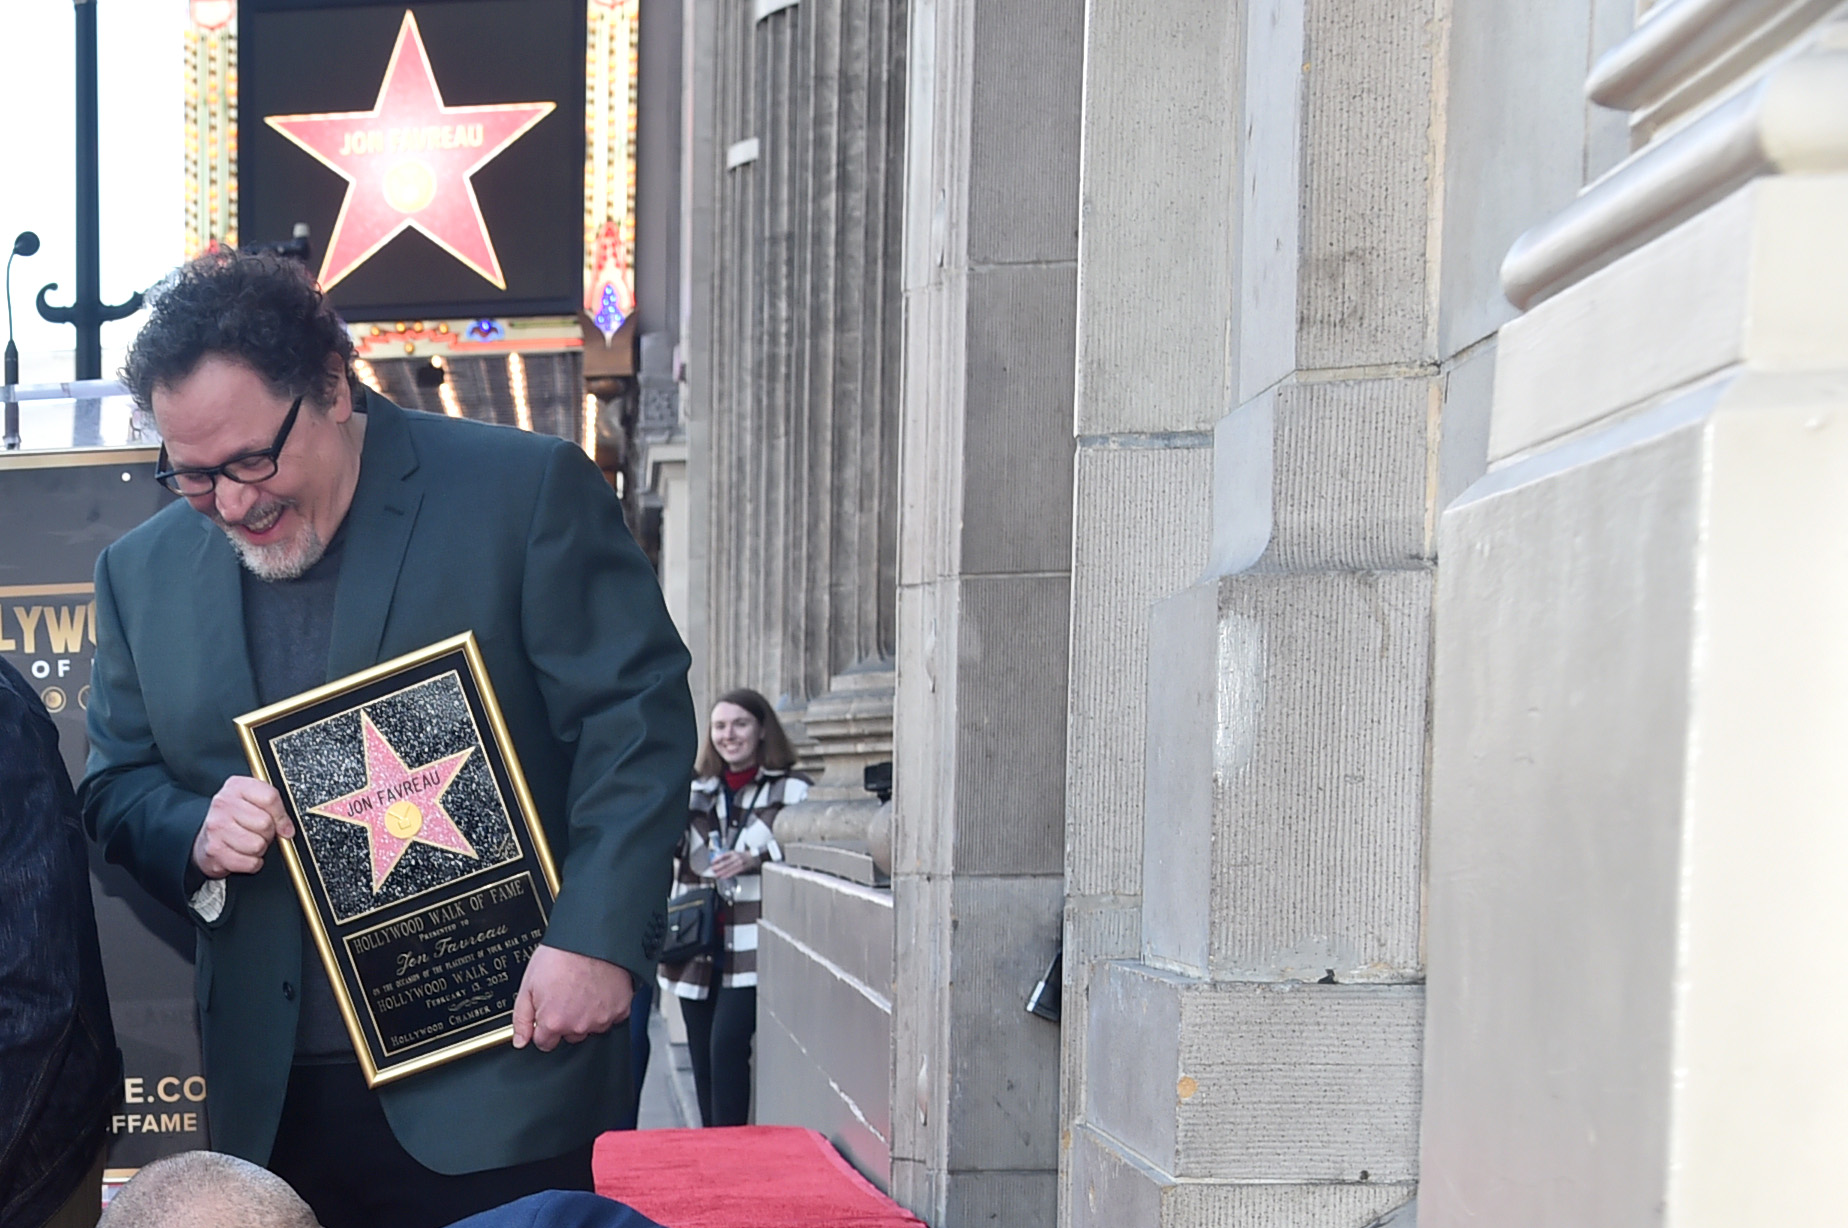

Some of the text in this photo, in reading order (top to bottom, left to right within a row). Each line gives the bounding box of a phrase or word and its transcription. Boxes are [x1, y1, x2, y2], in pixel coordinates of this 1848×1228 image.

[339, 123, 484, 156] JON FAVREAU
[31, 659, 71, 679] OF
[347, 770, 441, 817] JON FAVREAU
[354, 880, 524, 954] HOLLYWOOD WALK OF FAME
[460, 919, 469, 927] TO
[396, 924, 508, 976] Jon Favreau
[377, 978, 448, 1013] HOLLYWOOD
[452, 962, 489, 984] WALK
[493, 955, 508, 970] OF
[425, 989, 466, 1009] FEBRUARY
[390, 999, 507, 1047] HOLLYWOOD CHAMBER OF
[105, 1112, 197, 1134] FFAME
